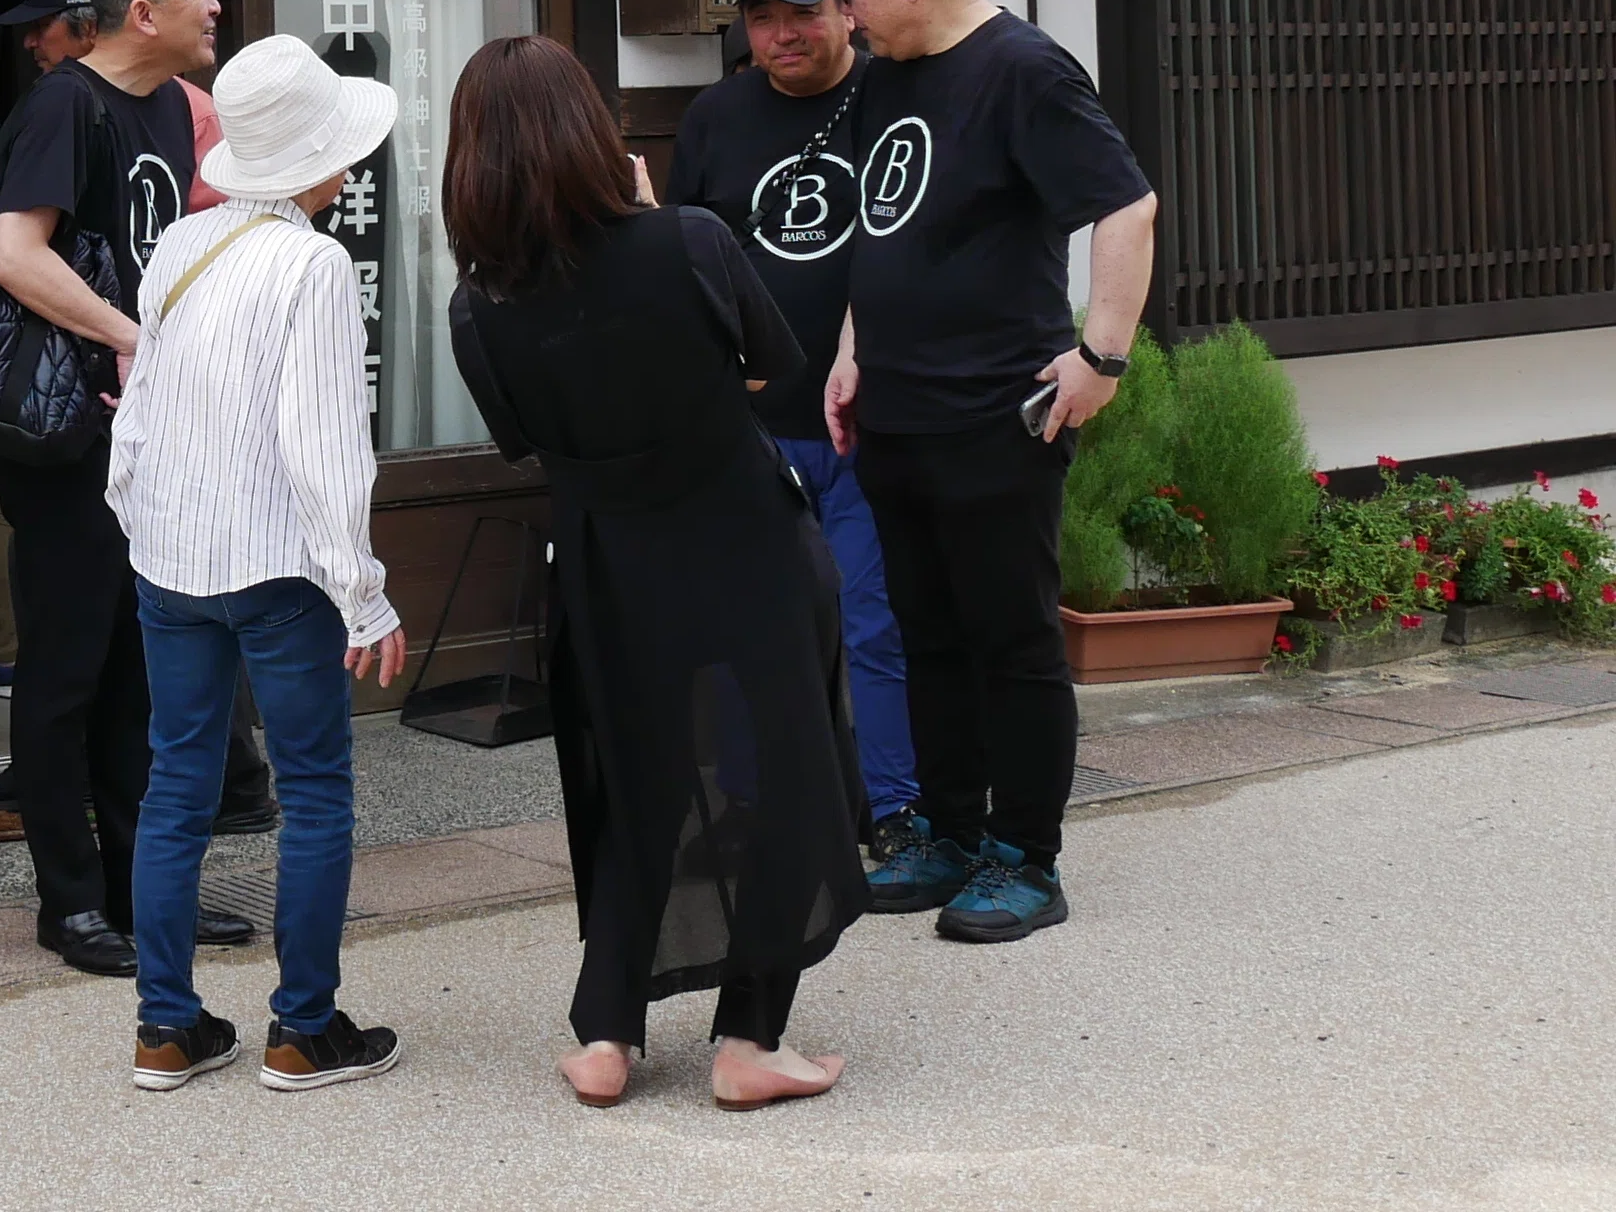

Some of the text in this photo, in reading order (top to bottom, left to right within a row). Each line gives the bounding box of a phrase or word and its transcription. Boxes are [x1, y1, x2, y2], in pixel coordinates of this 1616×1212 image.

[402, 1, 432, 217] 高級紳士服
[874, 139, 914, 202] B
[780, 174, 829, 229] B
[781, 230, 826, 243] BARCOS
